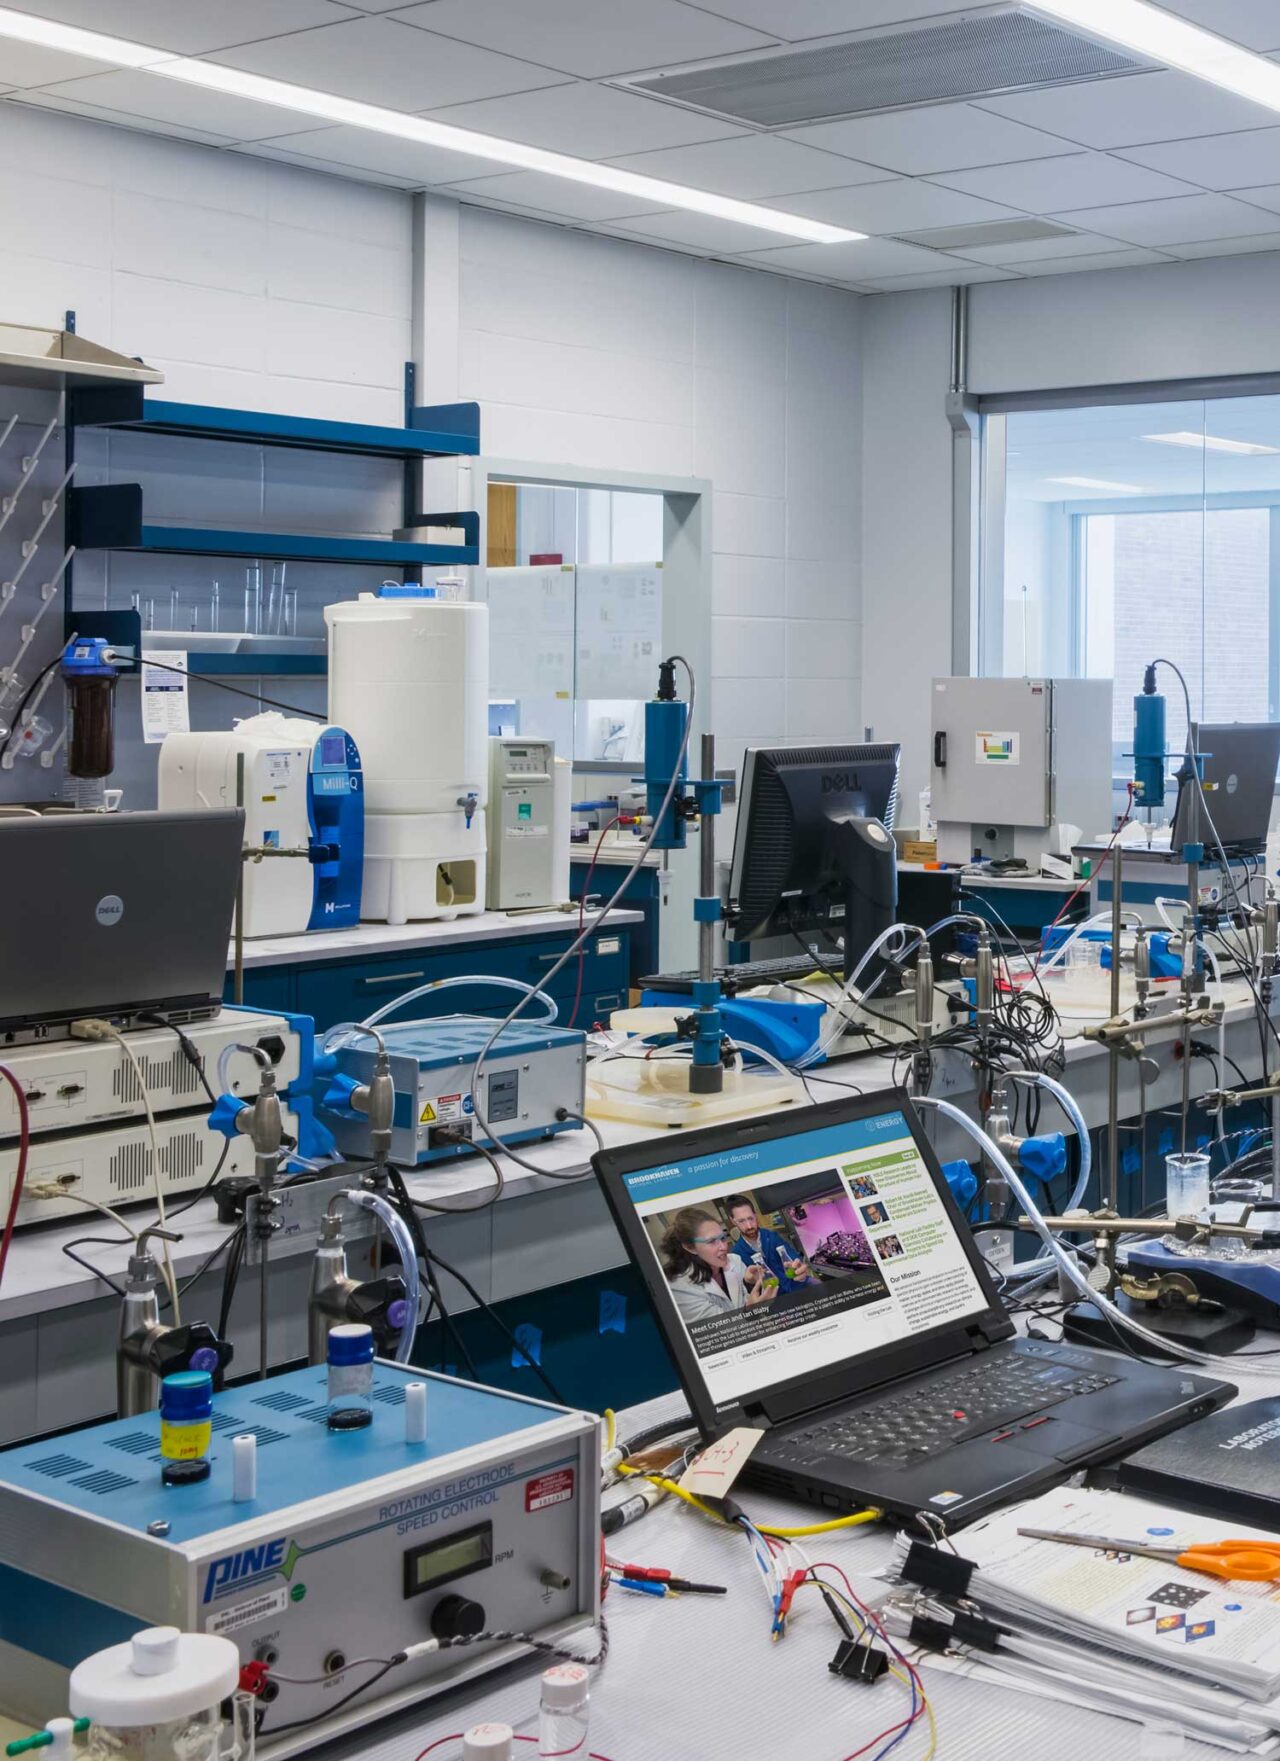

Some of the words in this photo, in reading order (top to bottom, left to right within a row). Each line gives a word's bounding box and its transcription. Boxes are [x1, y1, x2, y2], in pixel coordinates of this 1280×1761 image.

[322, 776, 358, 791] Milli-Q
[821, 773, 862, 793] DELL
[97, 904, 121, 915] DELL
[692, 1161, 719, 1173] passion
[717, 1158, 730, 1167] for
[728, 1151, 760, 1164] discovery
[627, 1168, 680, 1184] BROOKHAVEN
[900, 1270, 921, 1280] Mission
[690, 1325, 707, 1334] Meet
[706, 1317, 731, 1330] Crysten
[752, 1305, 770, 1316] Blaby
[716, 1401, 740, 1413] lenovo
[379, 1489, 442, 1521] ROTATING
[444, 1463, 516, 1496] ELECTRODE
[396, 1511, 438, 1537] SPEED
[441, 1490, 500, 1519] CONTROL
[495, 1550, 514, 1564] RPM
[203, 1537, 286, 1604] PINE
[251, 1629, 281, 1648] OUTPUT
